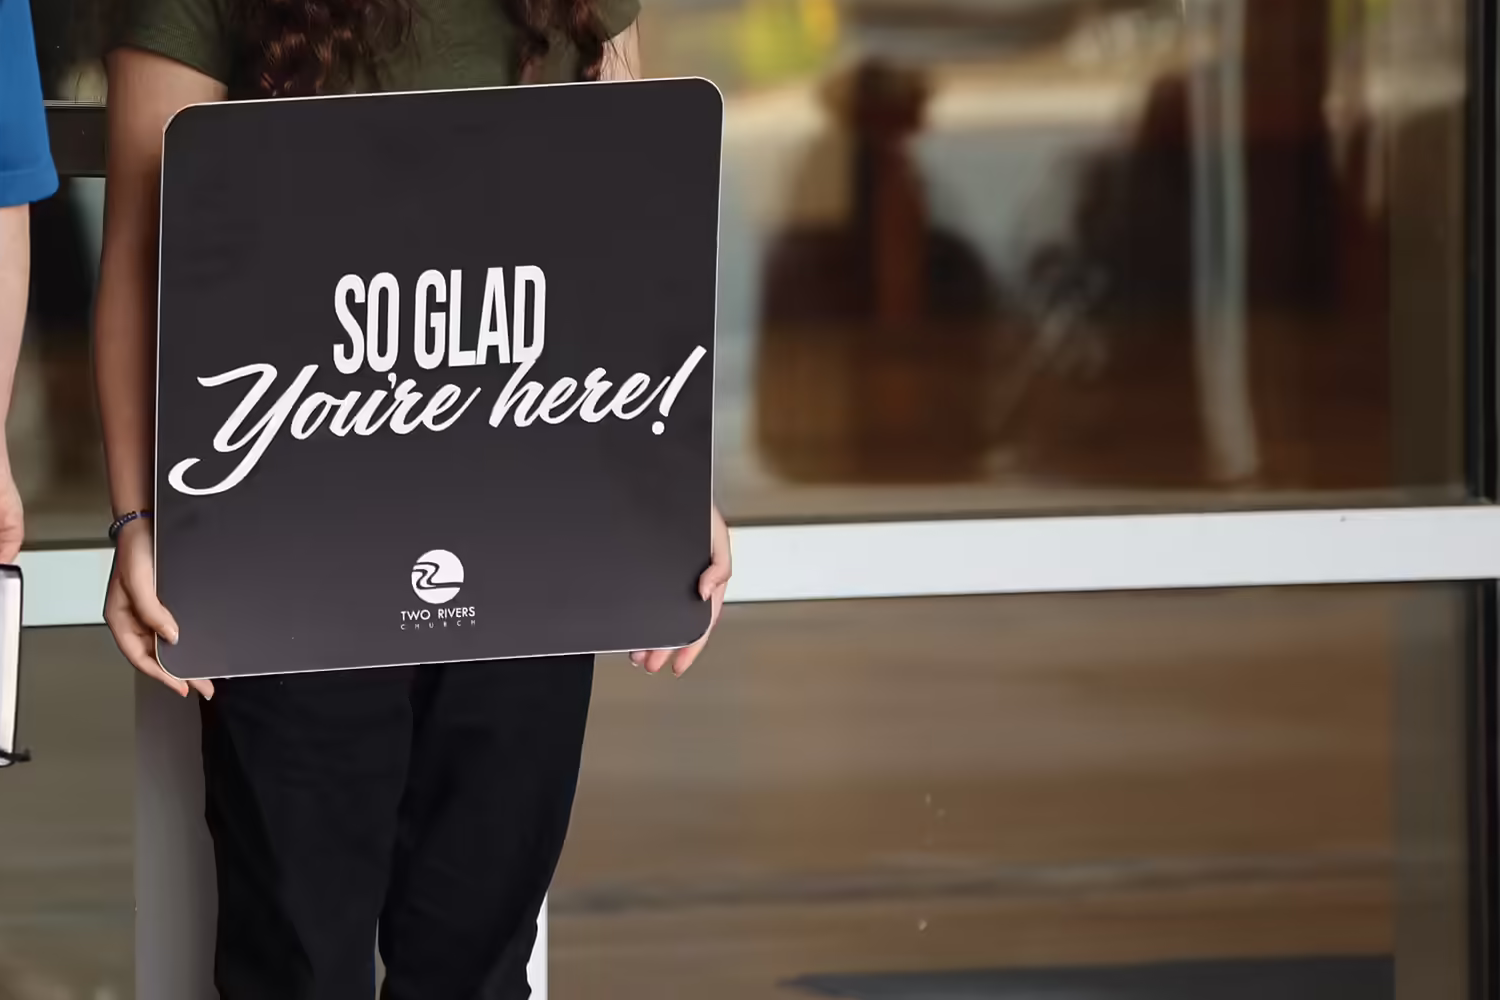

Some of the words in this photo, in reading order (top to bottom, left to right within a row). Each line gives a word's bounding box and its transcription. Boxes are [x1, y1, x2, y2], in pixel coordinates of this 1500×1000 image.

[333, 272, 400, 374] SO
[413, 265, 547, 369] GLAD
[168, 362, 482, 496] You're
[488, 345, 707, 435] here!
[400, 619, 476, 631] CHURCH
[401, 609, 431, 621] TWO
[438, 606, 476, 619] RIVERS
